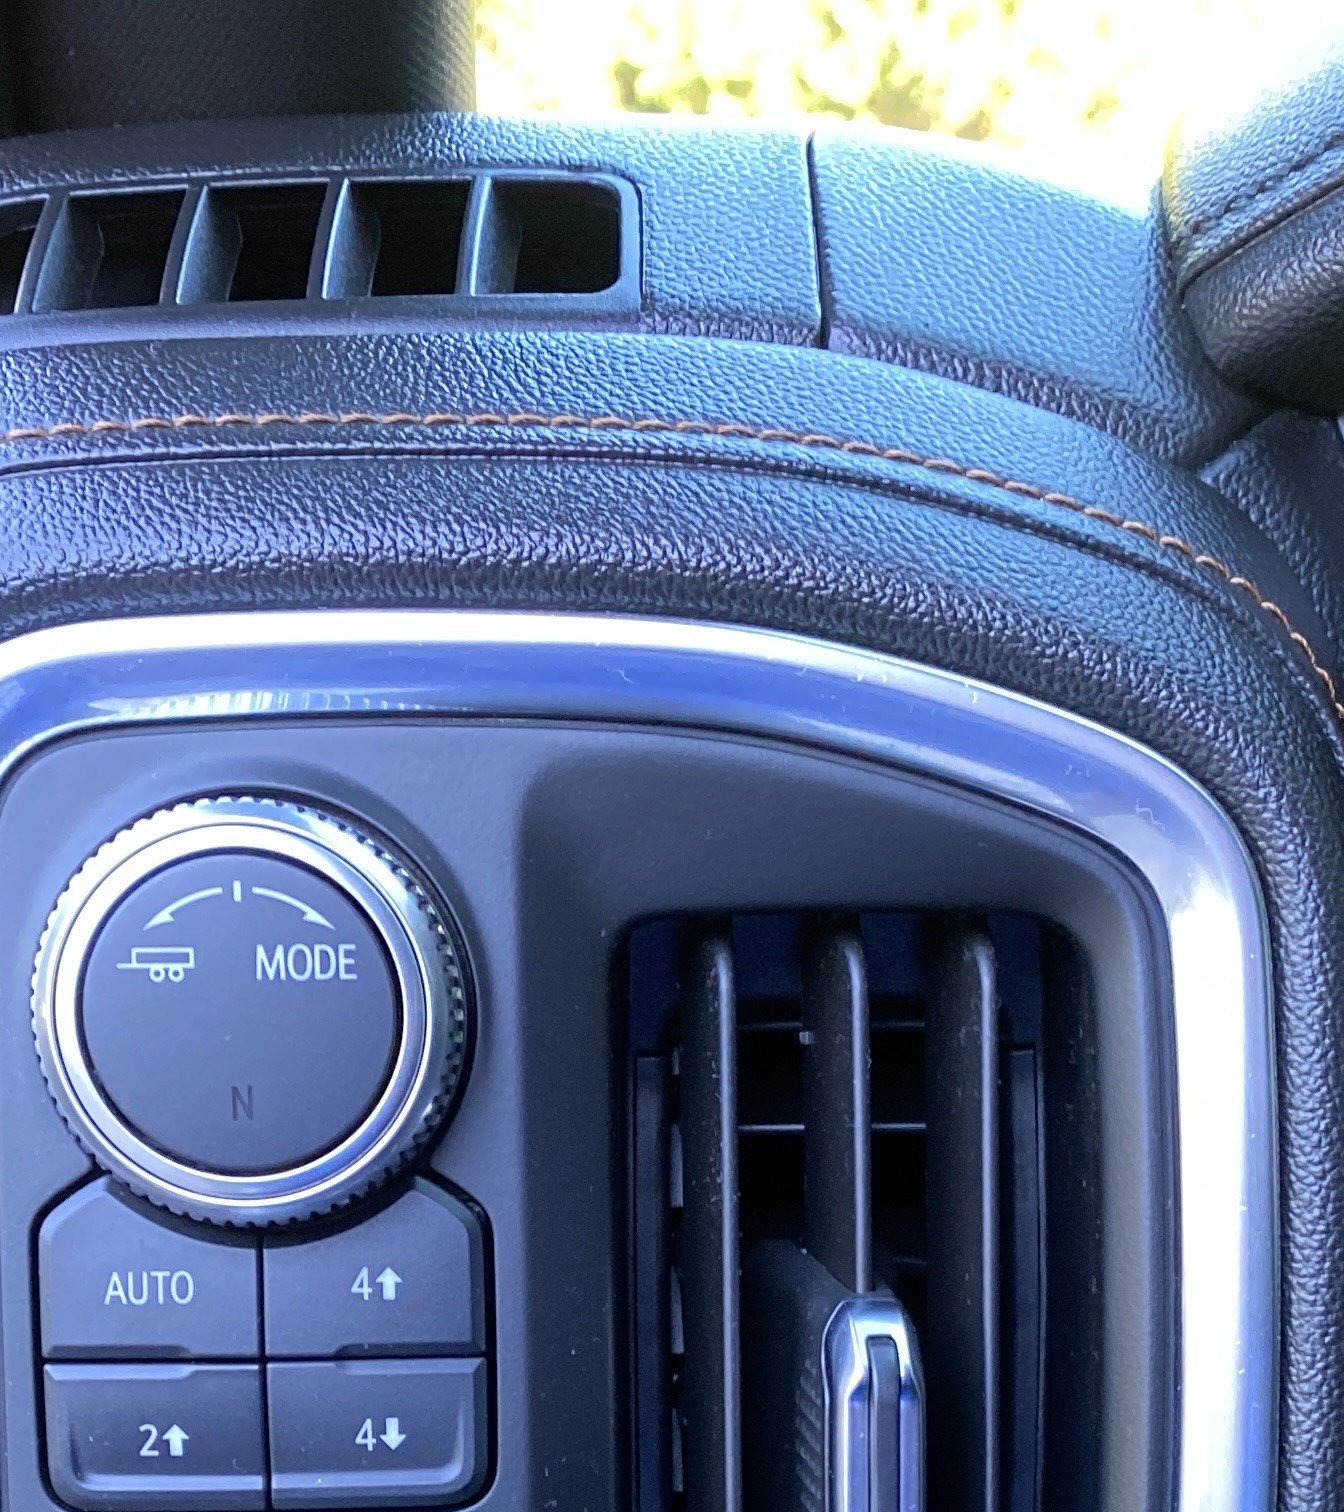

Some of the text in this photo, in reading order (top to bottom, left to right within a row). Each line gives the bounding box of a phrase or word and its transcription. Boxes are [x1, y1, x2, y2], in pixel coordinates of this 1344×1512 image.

[256, 944, 357, 981] MODE
[231, 1085, 254, 1121] N
[105, 1271, 195, 1305] AUTO
[351, 1267, 373, 1301] 4
[140, 1424, 160, 1457] 2
[355, 1418, 377, 1452] 4
